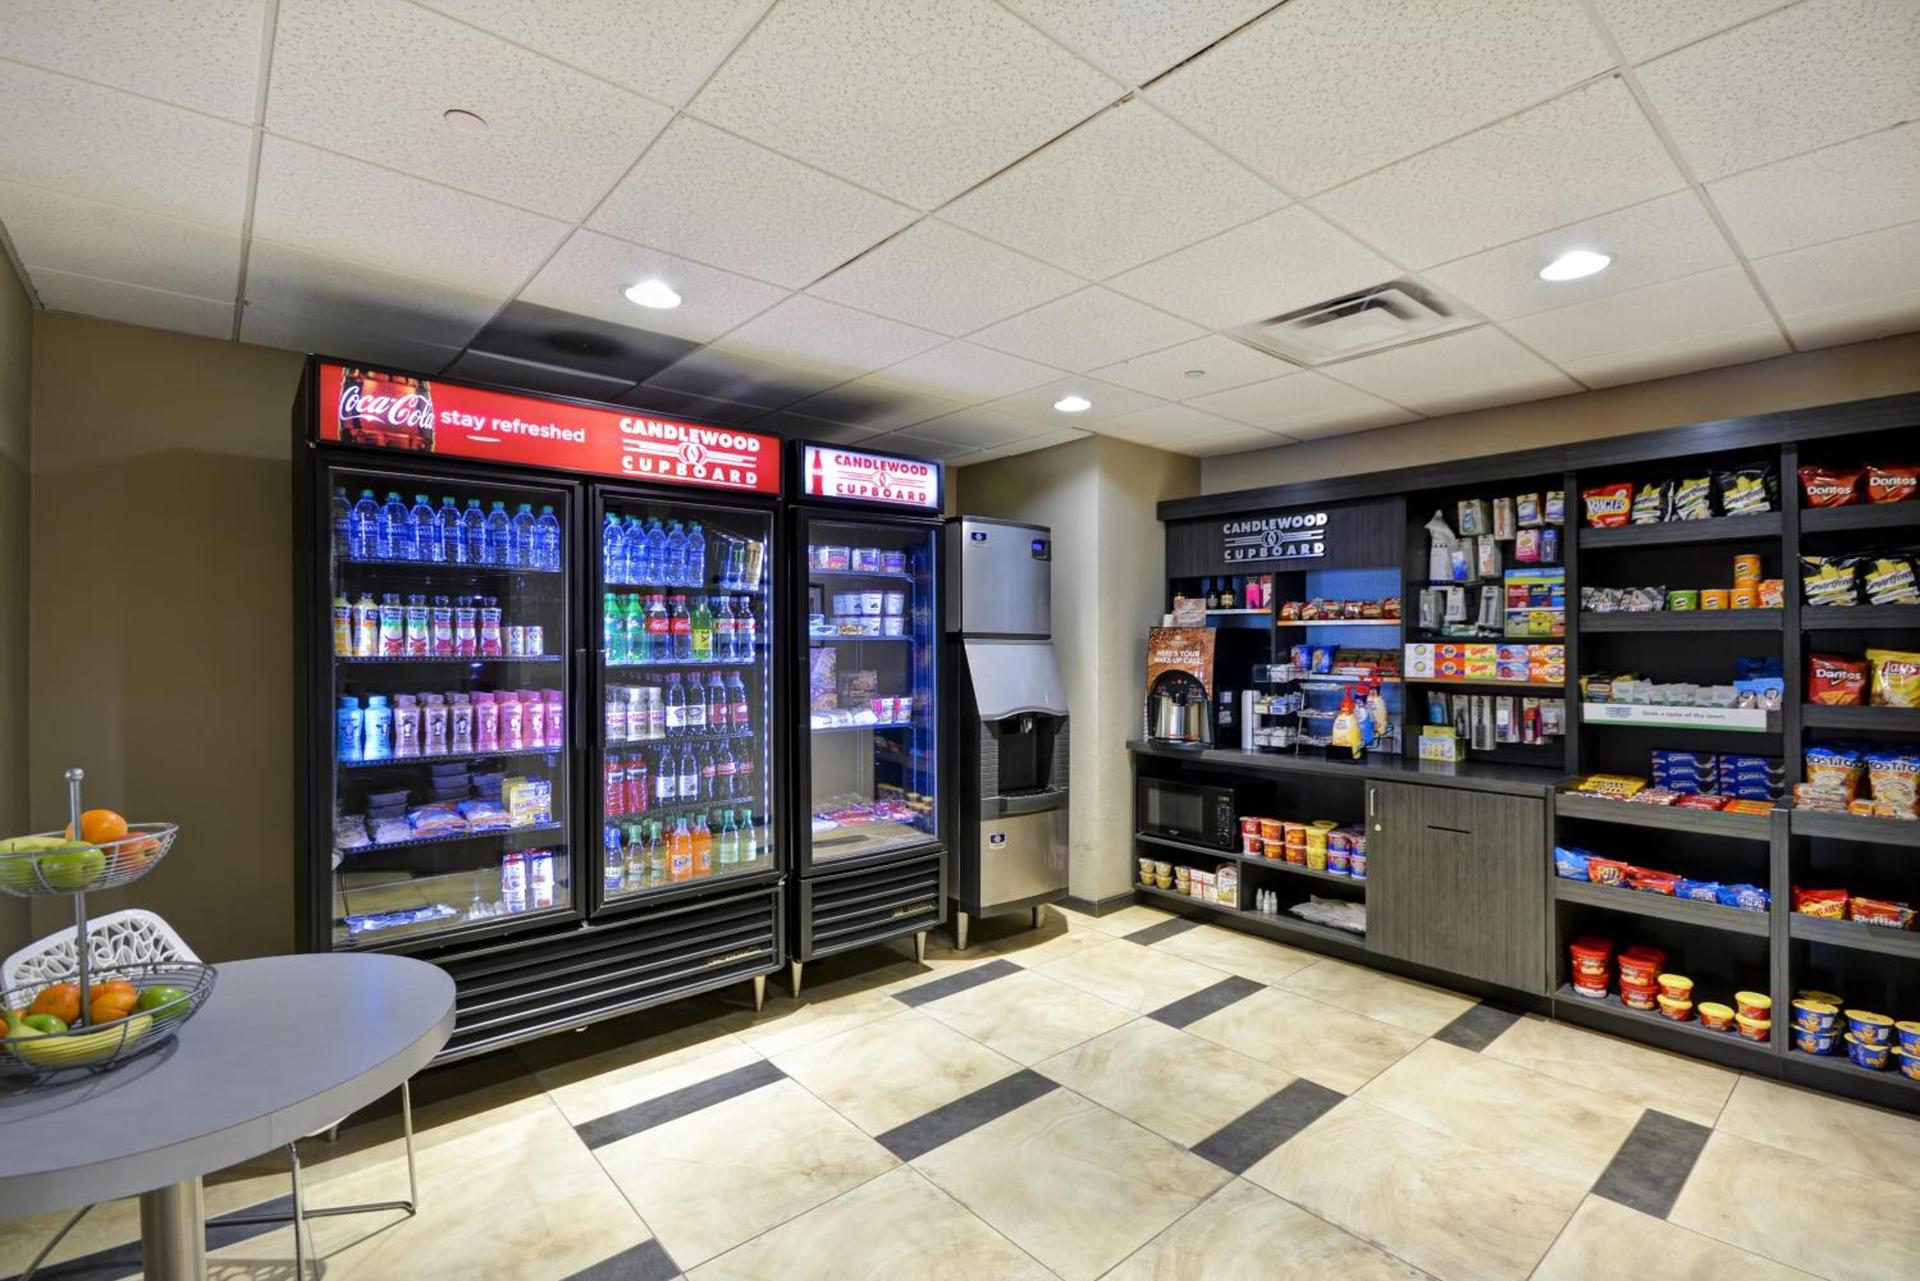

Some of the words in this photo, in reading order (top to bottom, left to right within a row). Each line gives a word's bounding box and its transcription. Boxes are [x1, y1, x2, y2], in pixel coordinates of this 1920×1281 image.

[340, 385, 434, 429] Coca-Cola
[440, 409, 486, 431] stay
[492, 416, 585, 442] refreshed
[619, 418, 760, 452] CANDLEWOOD
[621, 455, 757, 485] CUPBOARD
[834, 455, 928, 476] CANDLEWOOD
[1807, 486, 1851, 495] Doritos
[1869, 477, 1917, 486] Doritos
[835, 483, 926, 501] CUPBOARD
[1223, 513, 1328, 534] CANDLEWOOD
[1224, 543, 1325, 560] CUPBOARD
[1816, 668, 1861, 680] Doritos
[1853, 914, 1904, 928] Skittles
